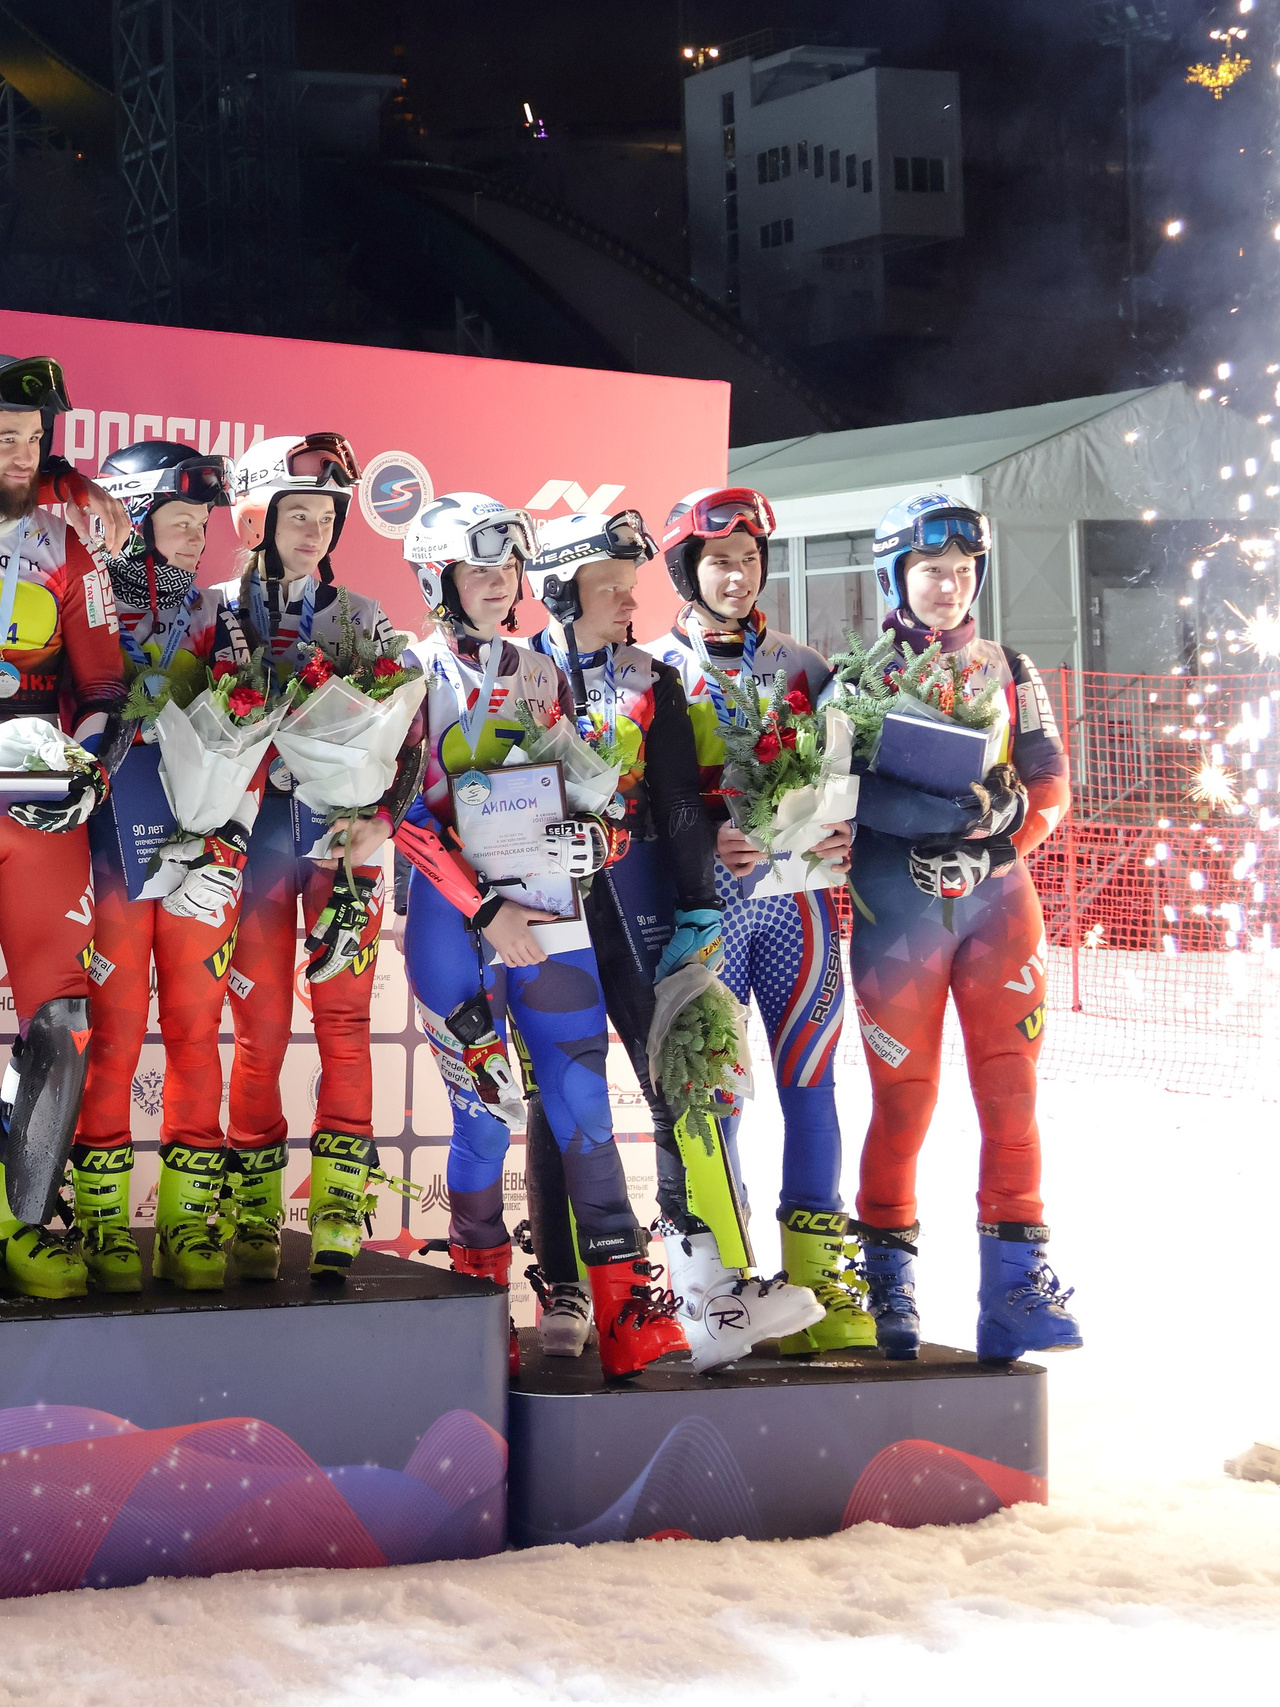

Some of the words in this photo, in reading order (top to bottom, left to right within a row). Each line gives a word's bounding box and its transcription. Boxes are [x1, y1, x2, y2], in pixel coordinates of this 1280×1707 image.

[532, 542, 592, 566] HEAD
[86, 583, 98, 627] TATNEFT
[1019, 692, 1030, 730] TATNEFT
[481, 797, 538, 815] ДИПЛОМ
[132, 825, 146, 836] 90
[147, 824, 165, 834] лет
[548, 825, 573, 836] SEIZ
[472, 848, 525, 859] ЛЕНИНГРАДСКАЯ
[336, 904, 347, 923] LEKI
[637, 915, 646, 926] 90
[809, 931, 840, 1025] RUSSIA
[868, 1034, 897, 1064] Freight
[873, 1025, 906, 1056] Federal
[441, 1064, 470, 1085] Freight
[314, 1133, 371, 1158] RC4
[787, 1210, 848, 1232] RC4
[596, 1238, 625, 1247] ATOMIC
